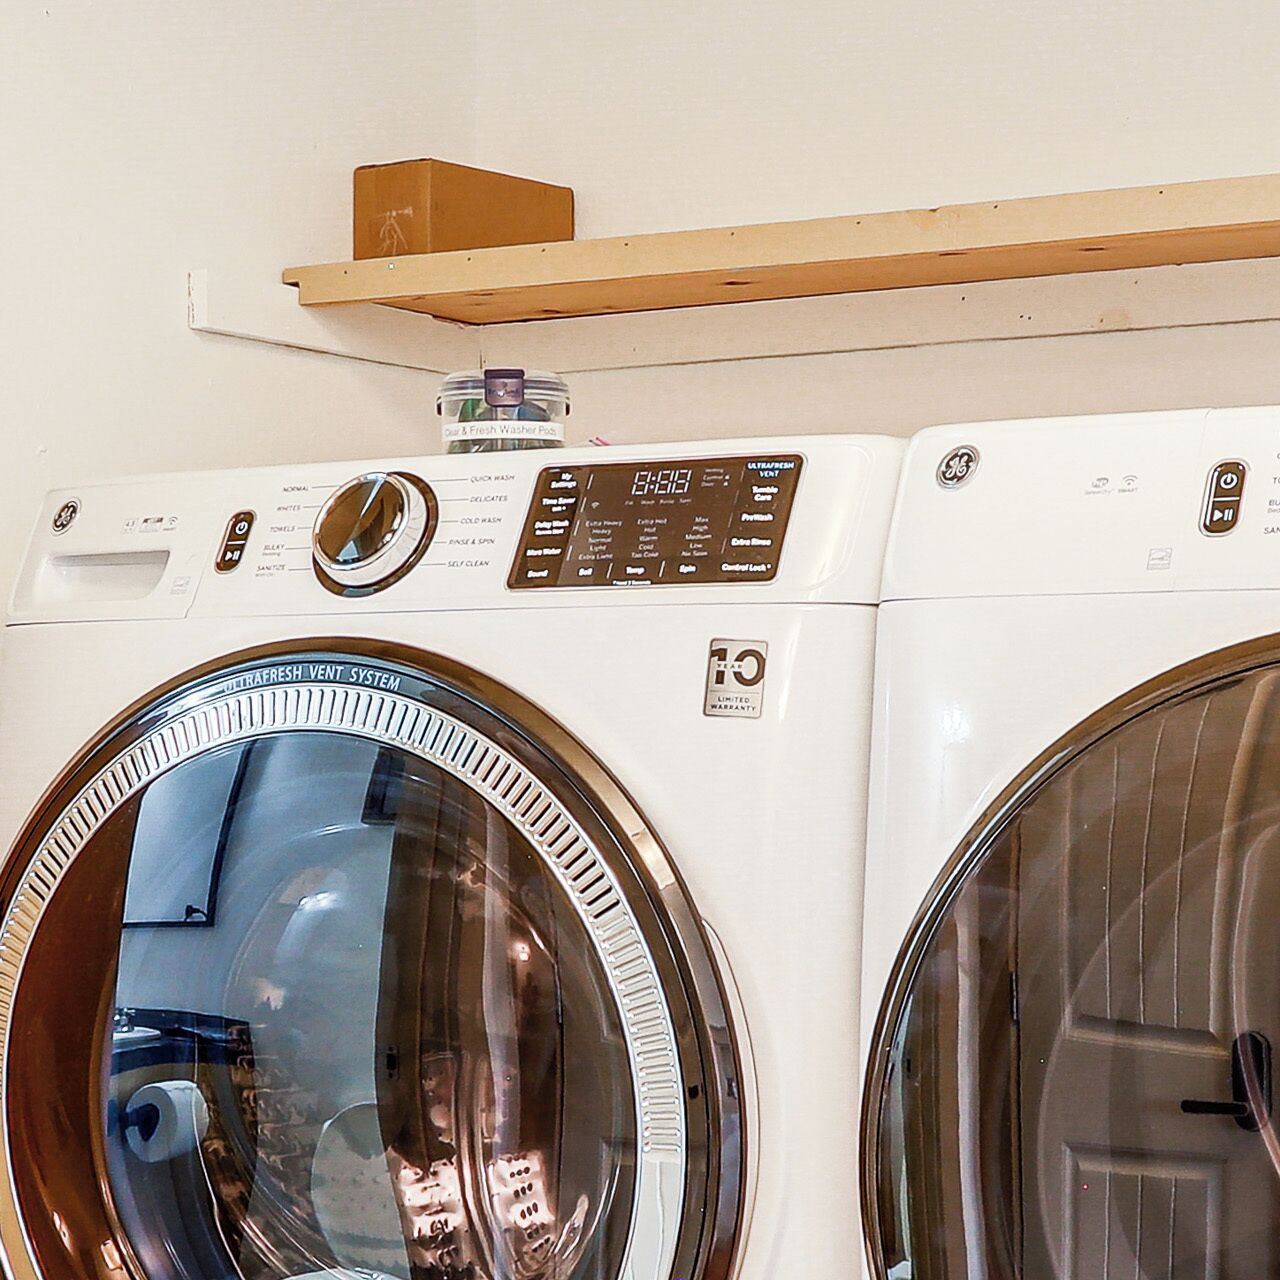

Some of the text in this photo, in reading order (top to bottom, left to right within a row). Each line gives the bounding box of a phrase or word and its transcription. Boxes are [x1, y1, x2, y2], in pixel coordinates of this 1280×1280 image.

[470, 425, 497, 435] Fresh
[499, 424, 536, 434] Washer
[539, 425, 557, 437] Pods
[754, 494, 773, 502] Care
[711, 648, 766, 686] 10
[224, 665, 401, 693] ULTRAFRESH VENT SYSTEM
